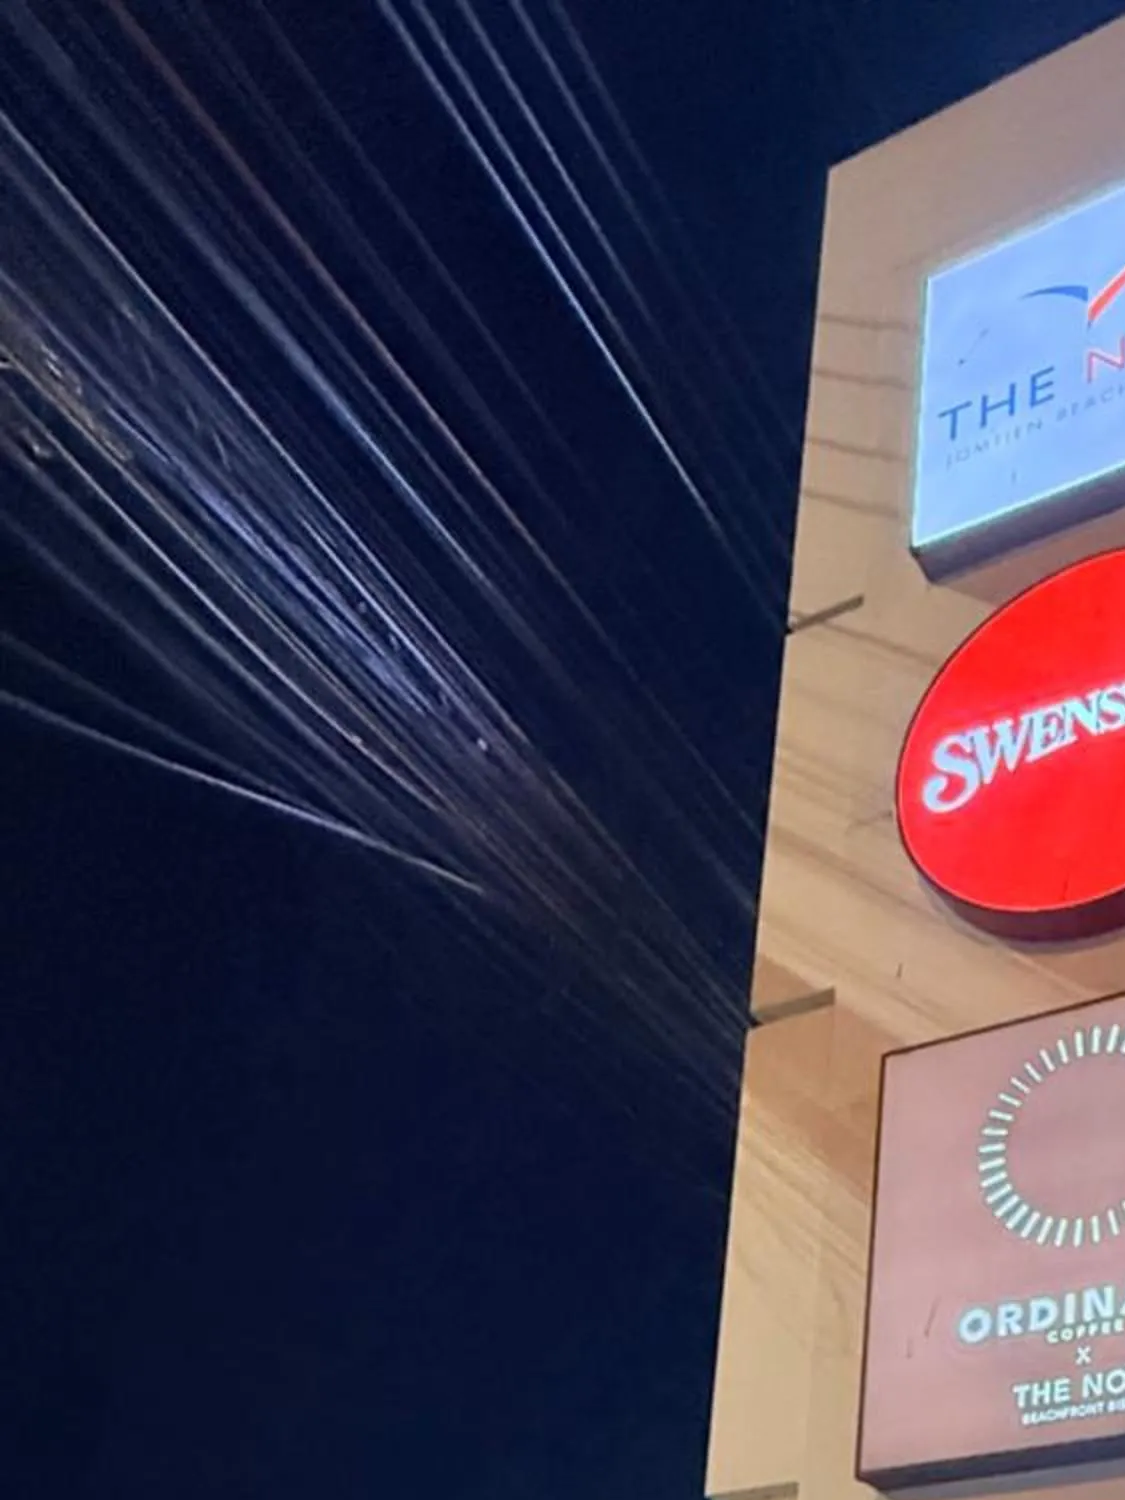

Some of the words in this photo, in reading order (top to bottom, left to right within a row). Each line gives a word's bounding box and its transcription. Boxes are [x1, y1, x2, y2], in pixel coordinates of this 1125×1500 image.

[938, 366, 1055, 440] THE
[1046, 1318, 1125, 1344] COFFEE
[1012, 1377, 1071, 1409] THE
[1021, 1401, 1104, 1426] BEACHFRONT
